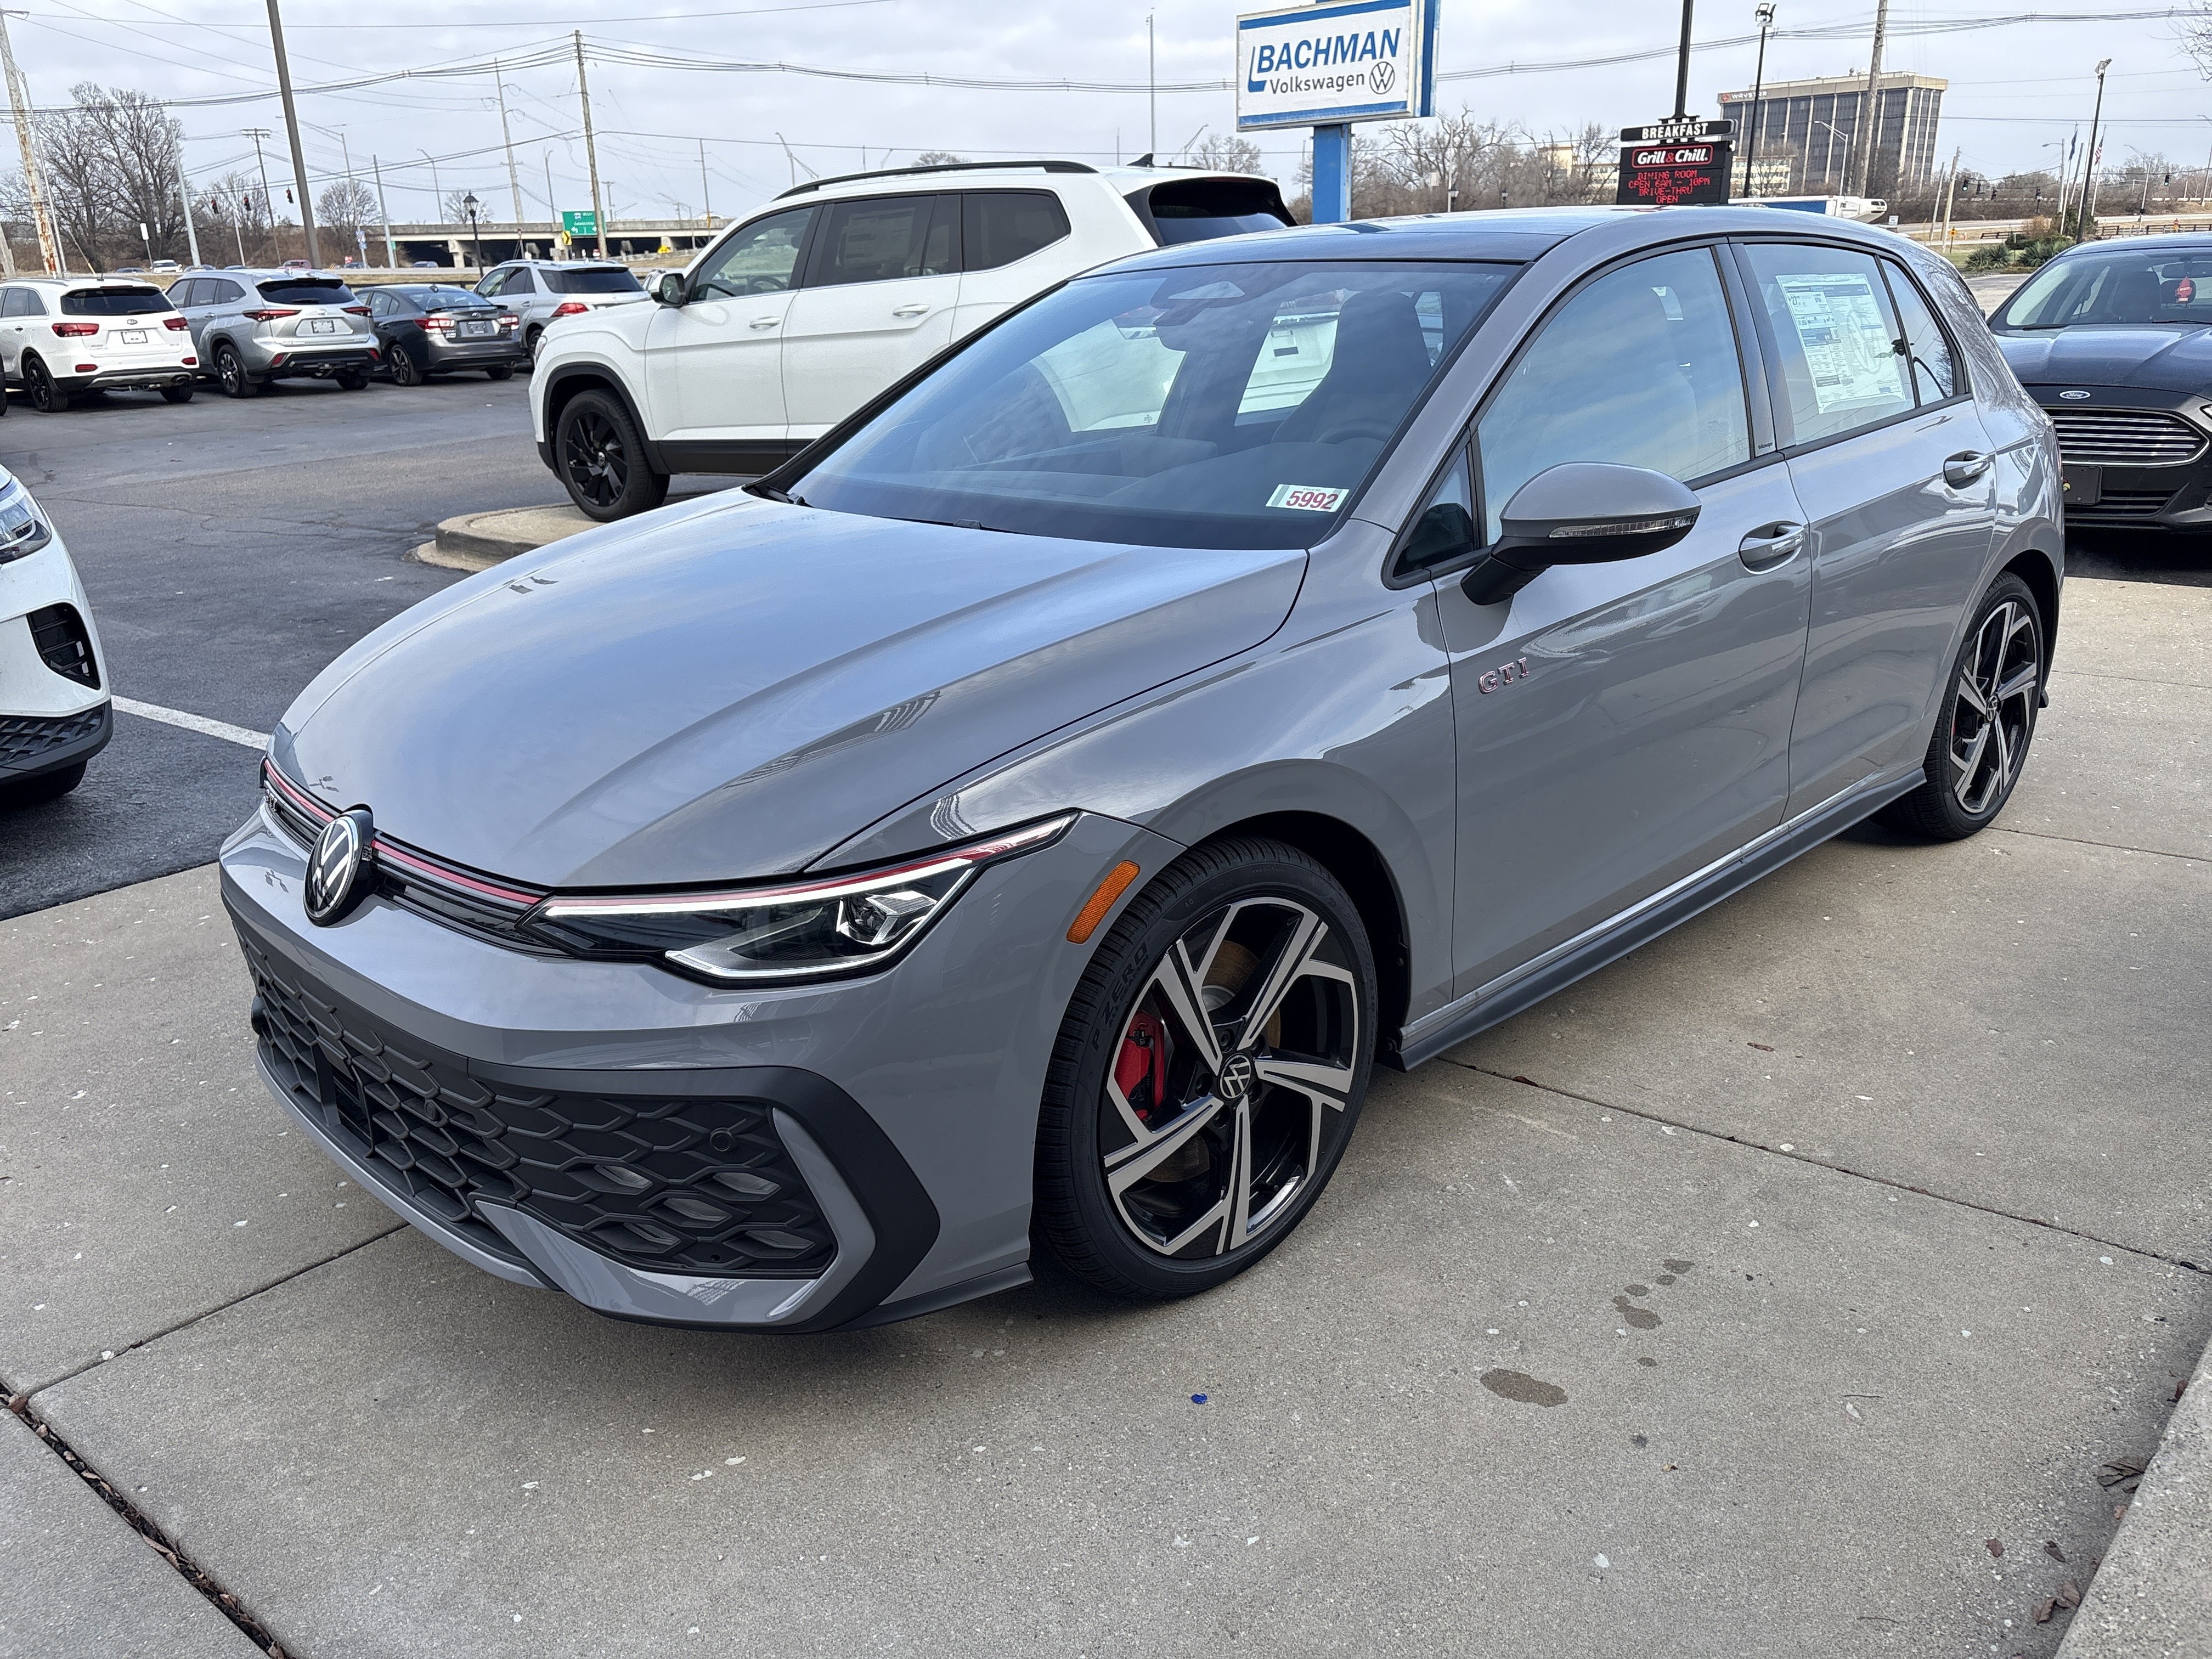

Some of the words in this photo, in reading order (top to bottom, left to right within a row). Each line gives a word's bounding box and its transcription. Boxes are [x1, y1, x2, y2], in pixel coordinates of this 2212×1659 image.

[1257, 27, 1401, 74] BACHMAN
[1269, 73, 1365, 94] Volkswagen
[1641, 123, 1708, 139] BREAKFAST
[1637, 171, 1670, 180] DINING
[1674, 170, 1697, 179] ROOM
[1628, 180, 1650, 189] OPEN
[1638, 186, 1693, 196] DRIVE-THRU
[1656, 195, 1679, 204] OPEN
[1286, 490, 1339, 510] 5992
[1479, 657, 1530, 694] GTI
[1092, 1028, 1100, 1052] P
[1101, 942, 1147, 1025] ZERO
